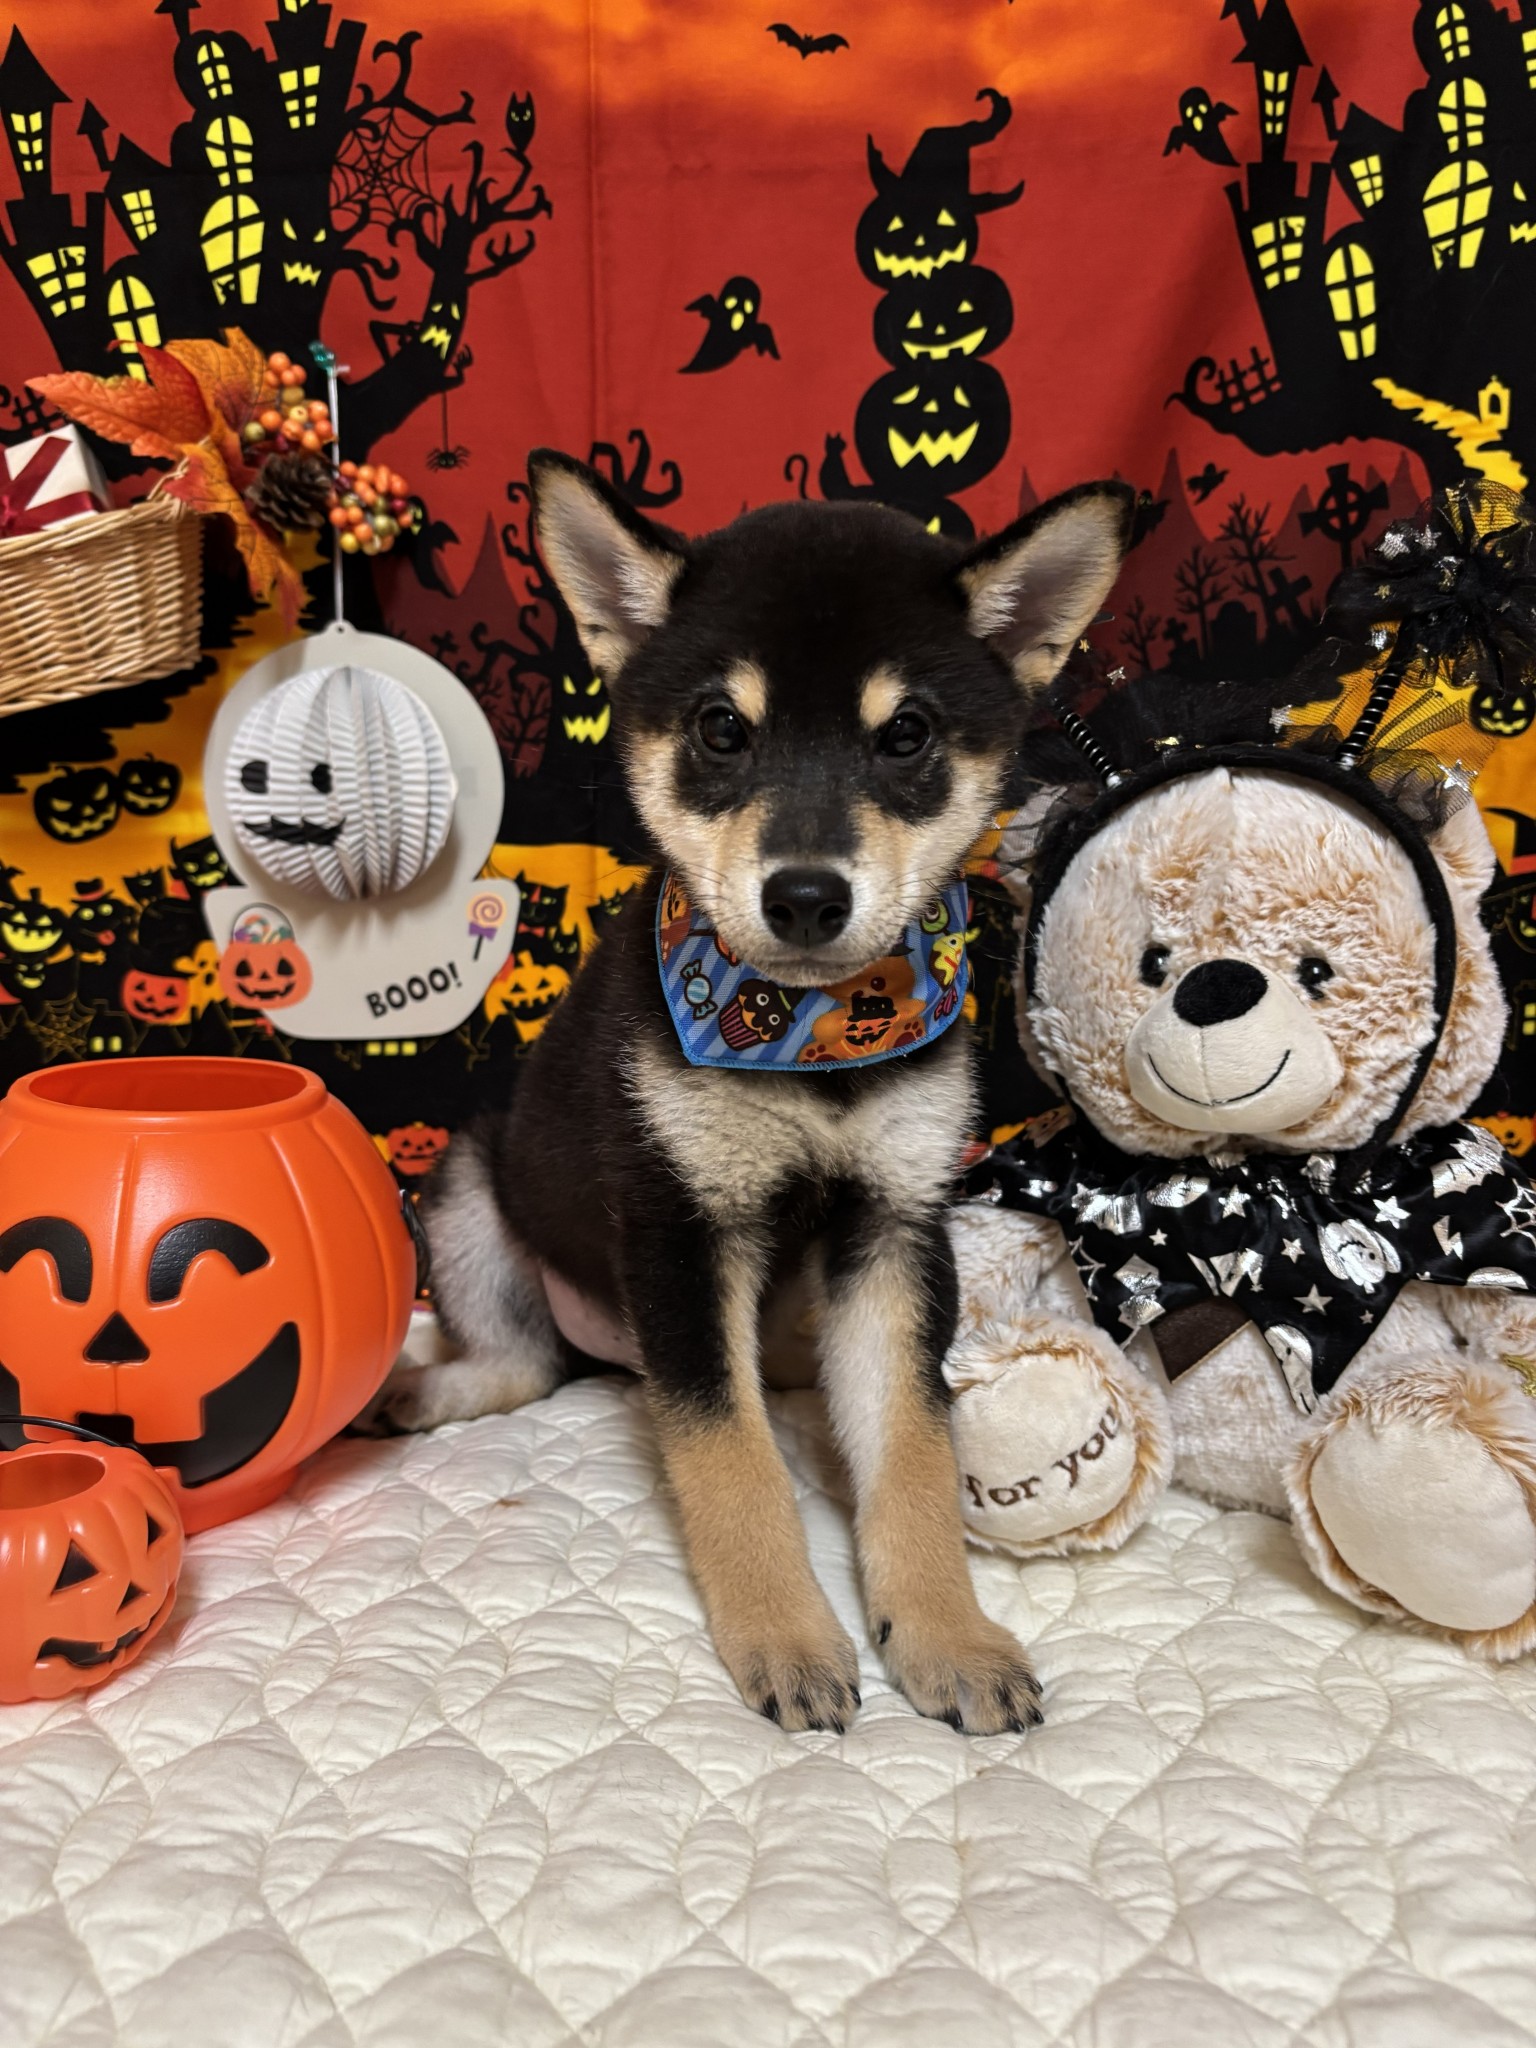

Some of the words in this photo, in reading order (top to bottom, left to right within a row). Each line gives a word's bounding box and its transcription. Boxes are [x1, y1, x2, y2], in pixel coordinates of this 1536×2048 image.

[366, 961, 462, 1018] BOOO!
[965, 1474, 1041, 1508] for
[1051, 1406, 1120, 1489] you
